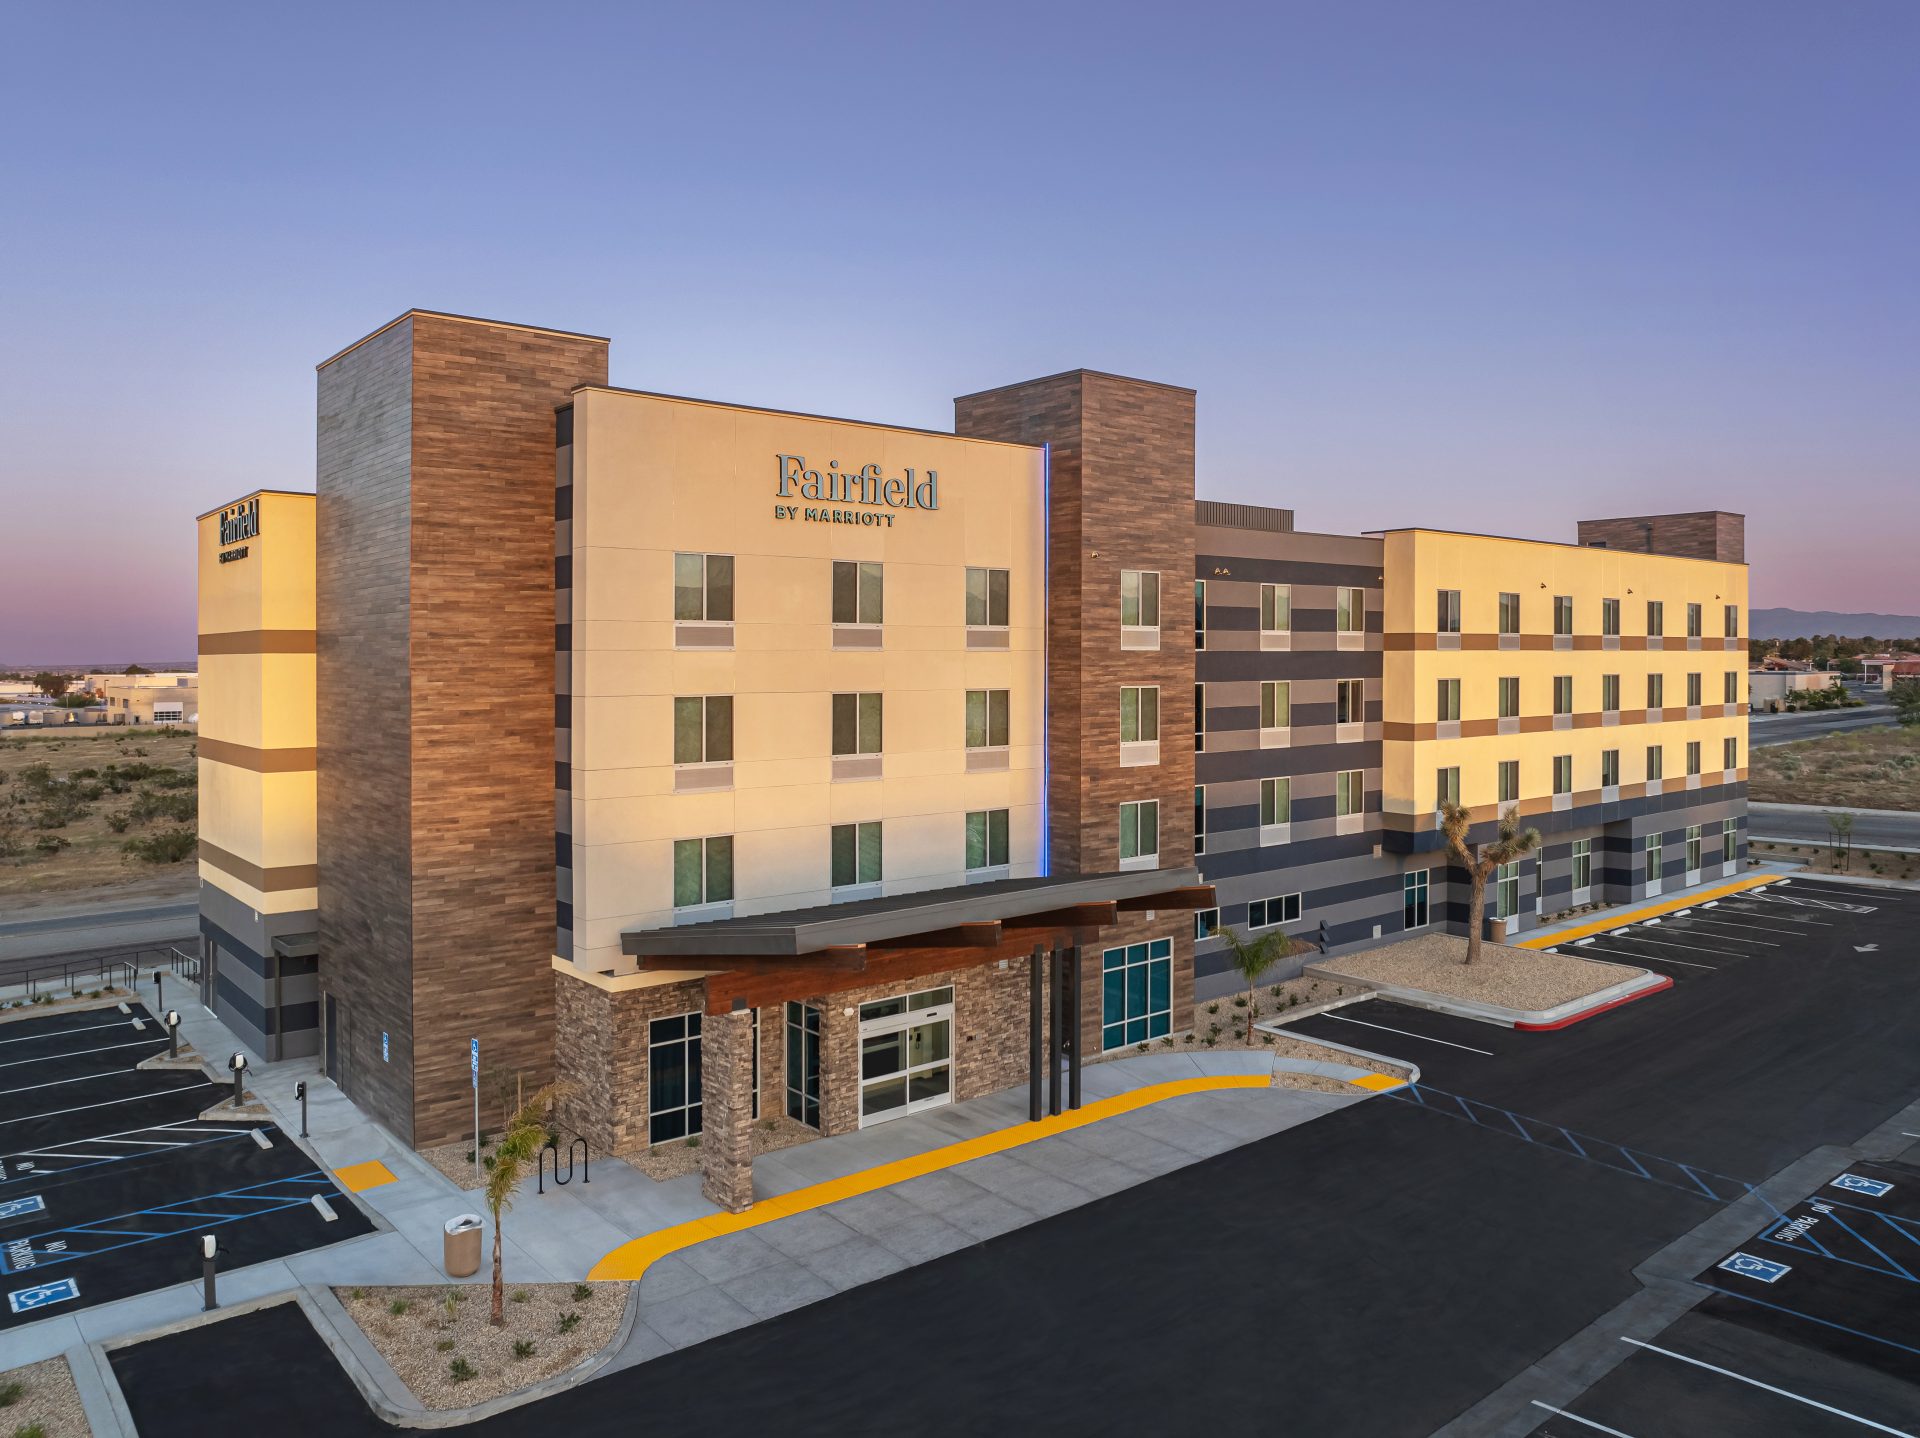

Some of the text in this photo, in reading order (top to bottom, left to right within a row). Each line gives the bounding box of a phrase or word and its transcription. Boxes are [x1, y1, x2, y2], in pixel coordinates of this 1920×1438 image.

[776, 453, 939, 510] Fairfield
[219, 498, 260, 546] Fairfield
[775, 505, 895, 527] BY MARRIOTT
[1774, 1202, 1835, 1242] NO PARKING
[8, 1238, 37, 1270] PARKING
[45, 1240, 67, 1253] NO
